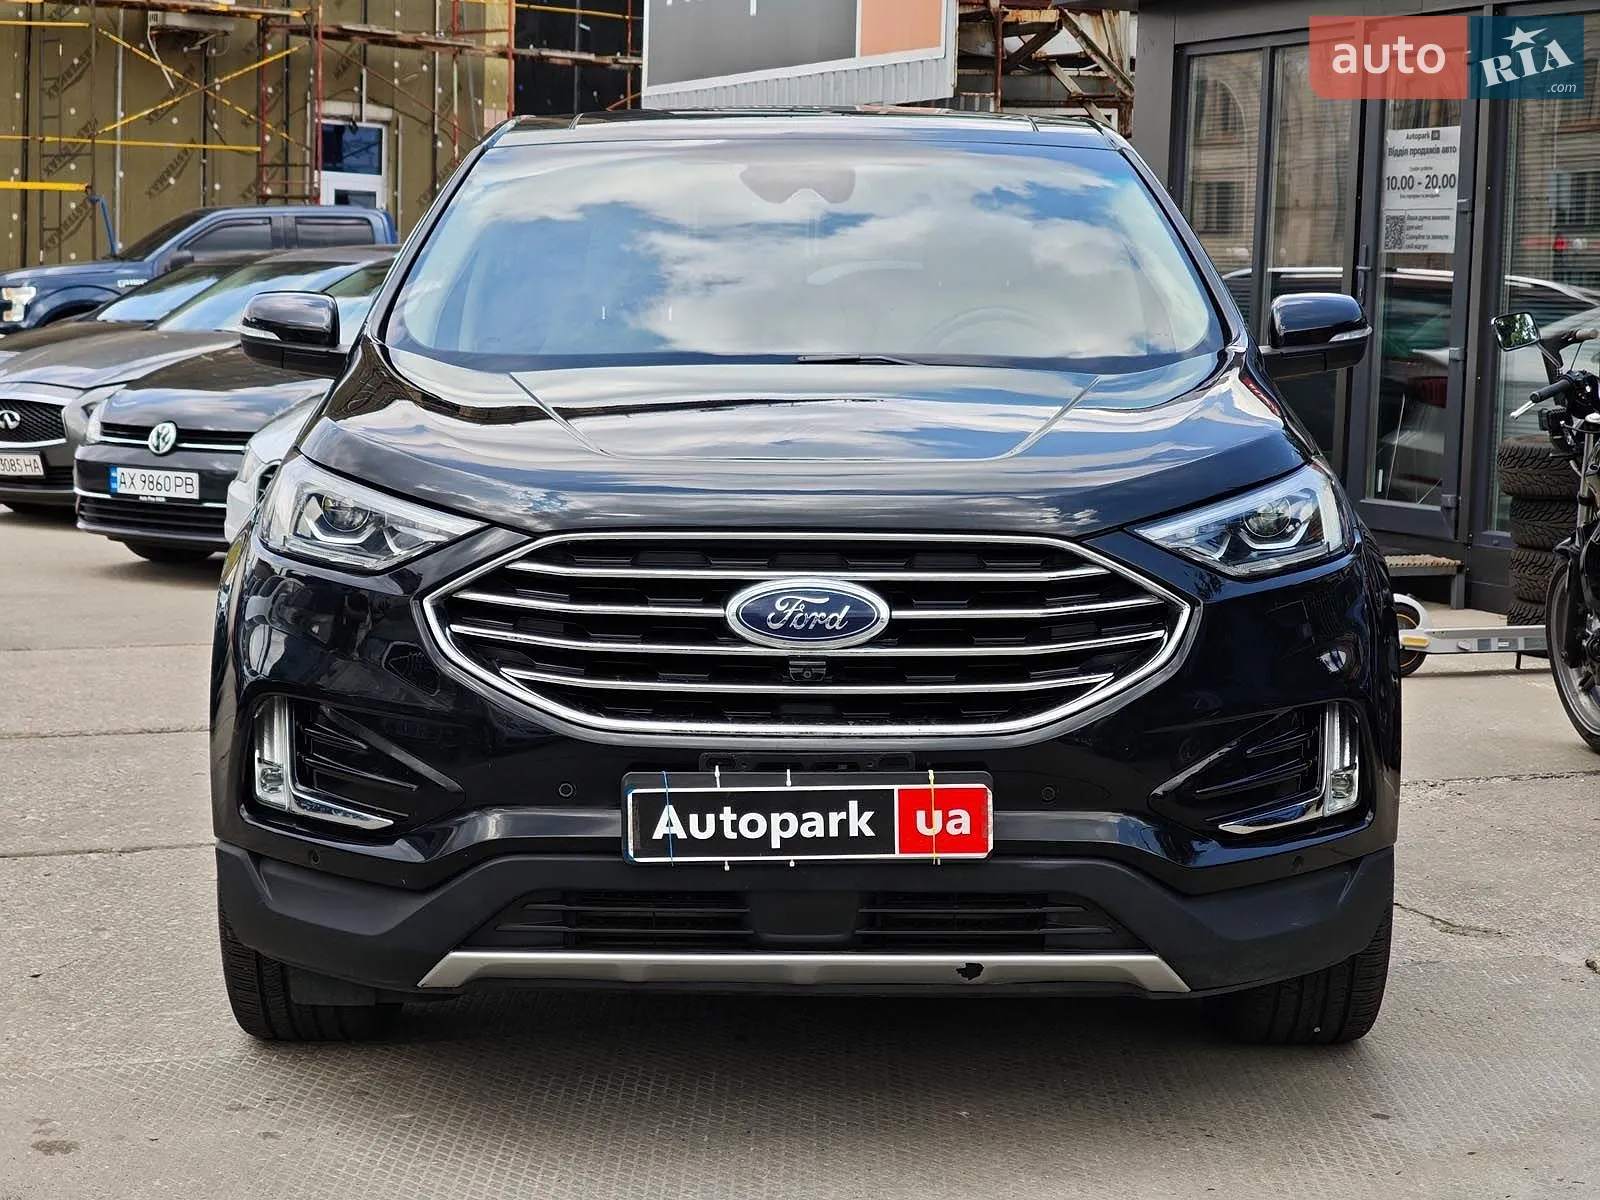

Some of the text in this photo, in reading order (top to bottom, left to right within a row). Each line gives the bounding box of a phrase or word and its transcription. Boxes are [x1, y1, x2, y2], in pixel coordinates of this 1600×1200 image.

[1441, 145, 1457, 154] авто
[1386, 175, 1414, 191] 10.00
[1425, 173, 1456, 190] 20.00
[24, 459, 42, 473] HA
[119, 472, 196, 494] AX 9860 PB
[766, 595, 851, 630] Ford
[652, 800, 971, 849] Autopark ua
